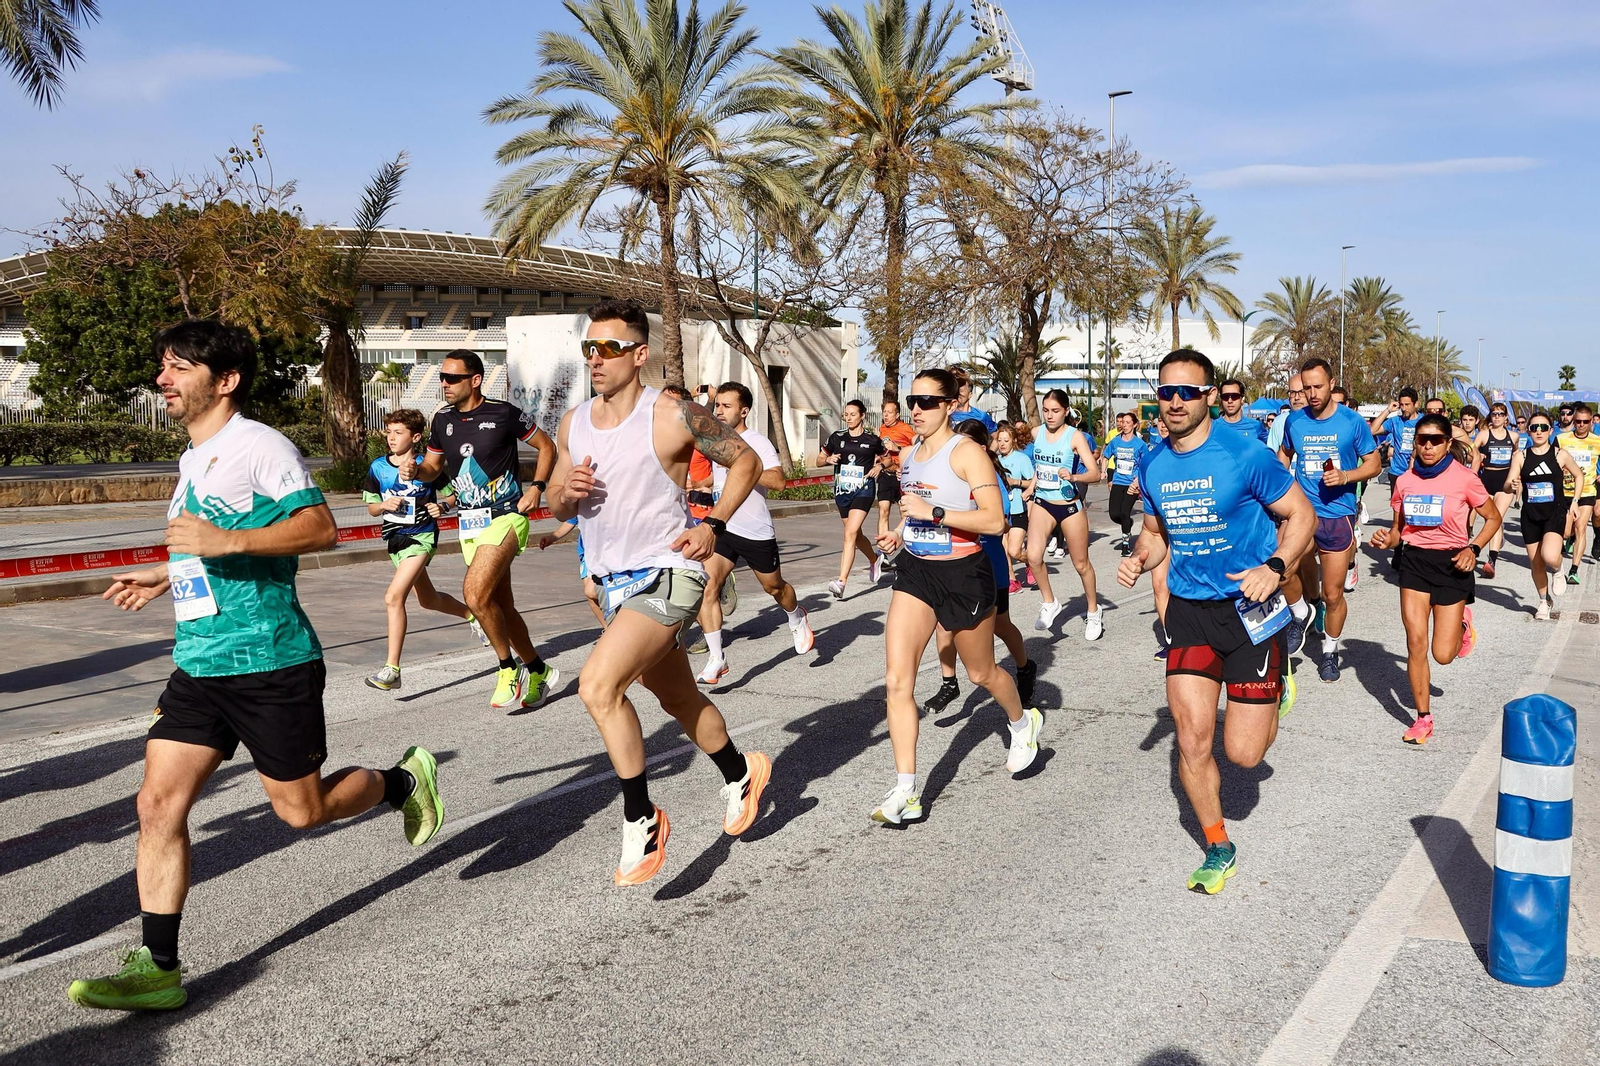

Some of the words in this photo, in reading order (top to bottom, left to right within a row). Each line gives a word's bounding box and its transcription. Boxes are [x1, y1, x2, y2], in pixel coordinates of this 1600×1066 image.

[1303, 434, 1337, 443] mayoral
[1034, 454, 1062, 463] nerja
[1161, 475, 1213, 493] mayoral
[1161, 498, 1214, 510] RUNNING
[1412, 504, 1431, 514] 508
[1167, 507, 1209, 517] MAKES
[464, 518, 486, 529] 1233
[1166, 516, 1207, 525] FRIENDS
[913, 527, 935, 540] 945
[171, 580, 197, 599] 32
